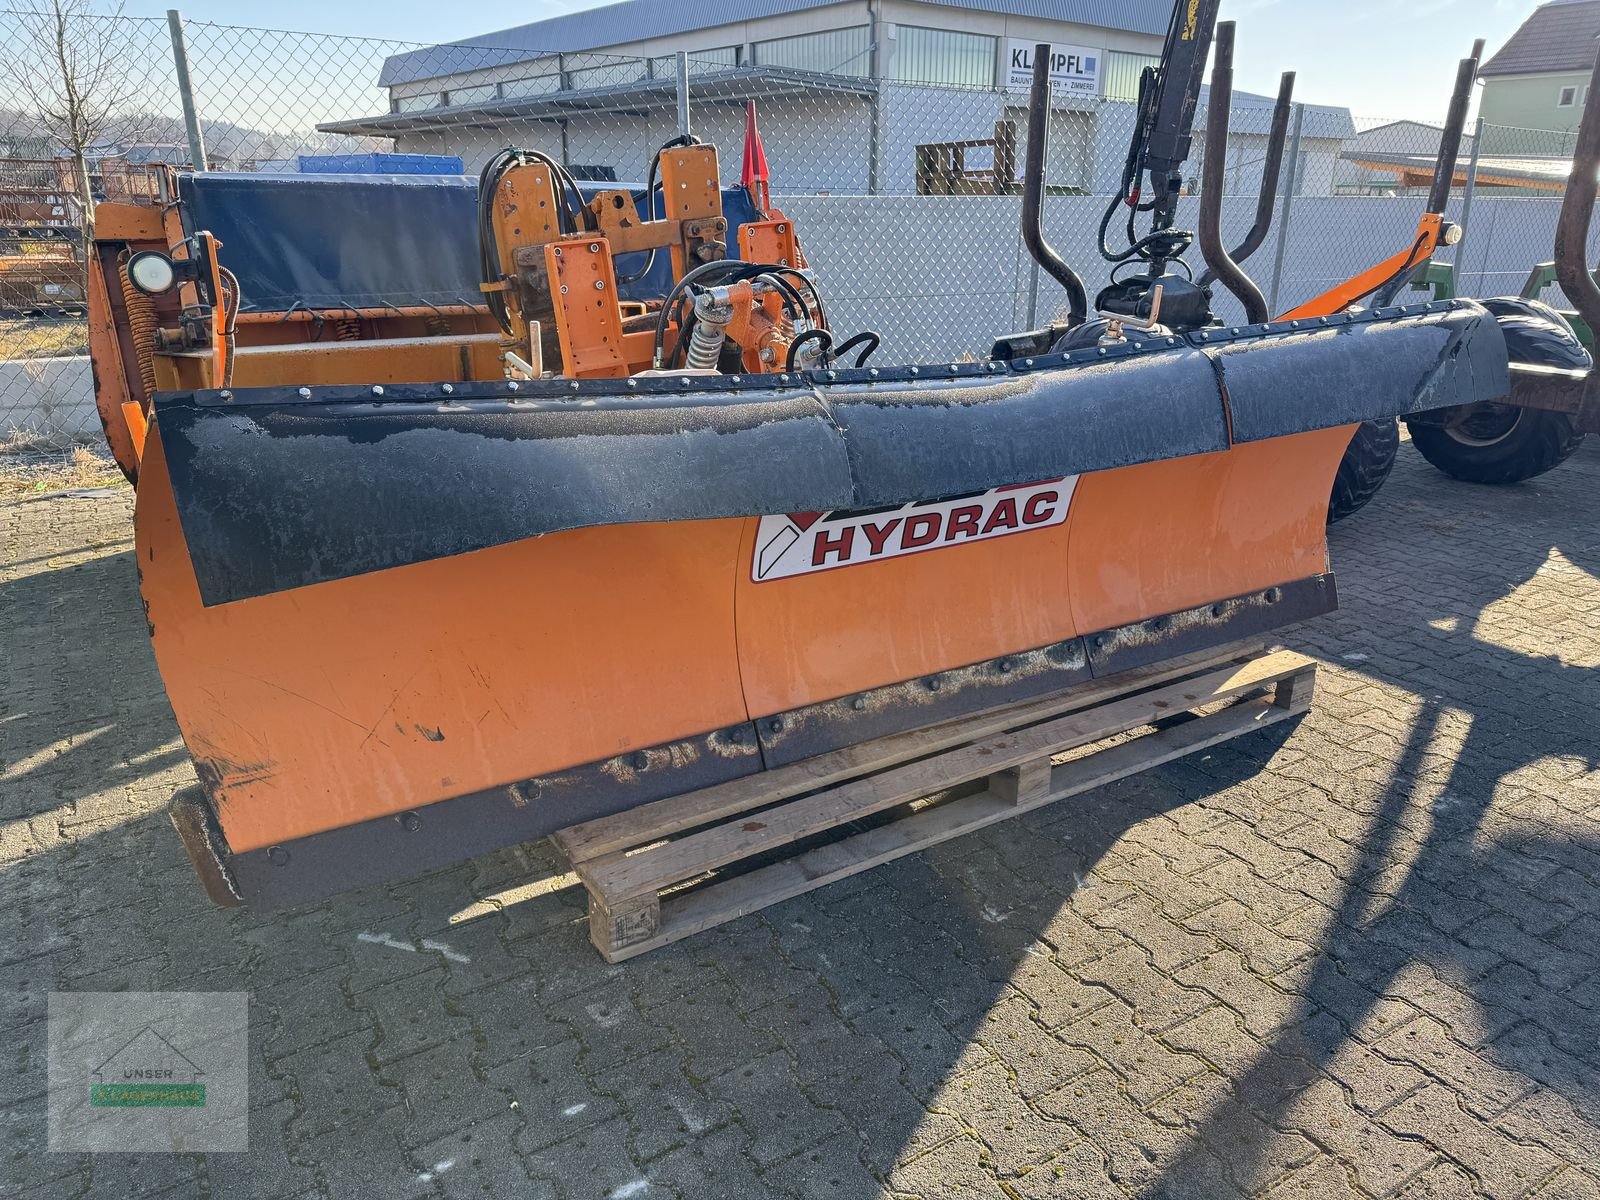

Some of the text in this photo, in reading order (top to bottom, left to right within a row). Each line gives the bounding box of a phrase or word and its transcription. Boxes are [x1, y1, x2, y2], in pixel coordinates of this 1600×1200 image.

[1012, 48, 1083, 75] KLMPFL
[1070, 81, 1095, 91] ZIMMEREI
[811, 490, 1059, 567] HYDRAC
